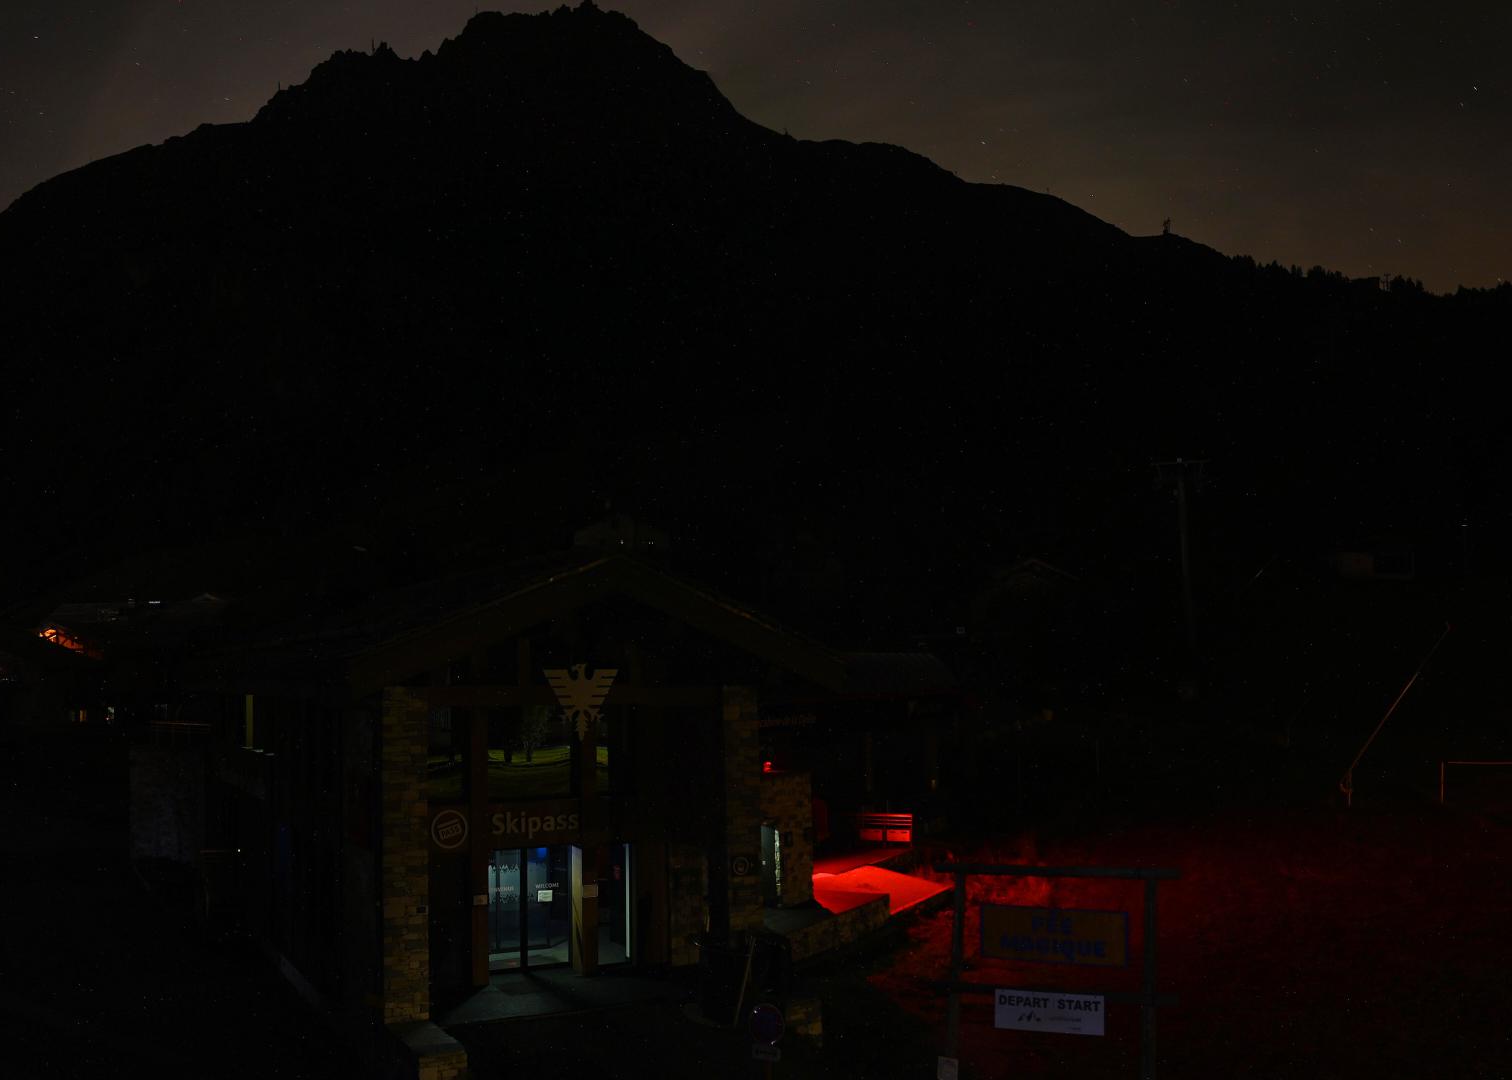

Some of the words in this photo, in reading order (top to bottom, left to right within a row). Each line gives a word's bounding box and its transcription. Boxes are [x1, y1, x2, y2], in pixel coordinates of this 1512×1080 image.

[491, 811, 579, 839] Skipass
[1000, 930, 1106, 960] MAGIQUE
[999, 995, 1049, 1008] DEPART
[1057, 999, 1101, 1012] START
